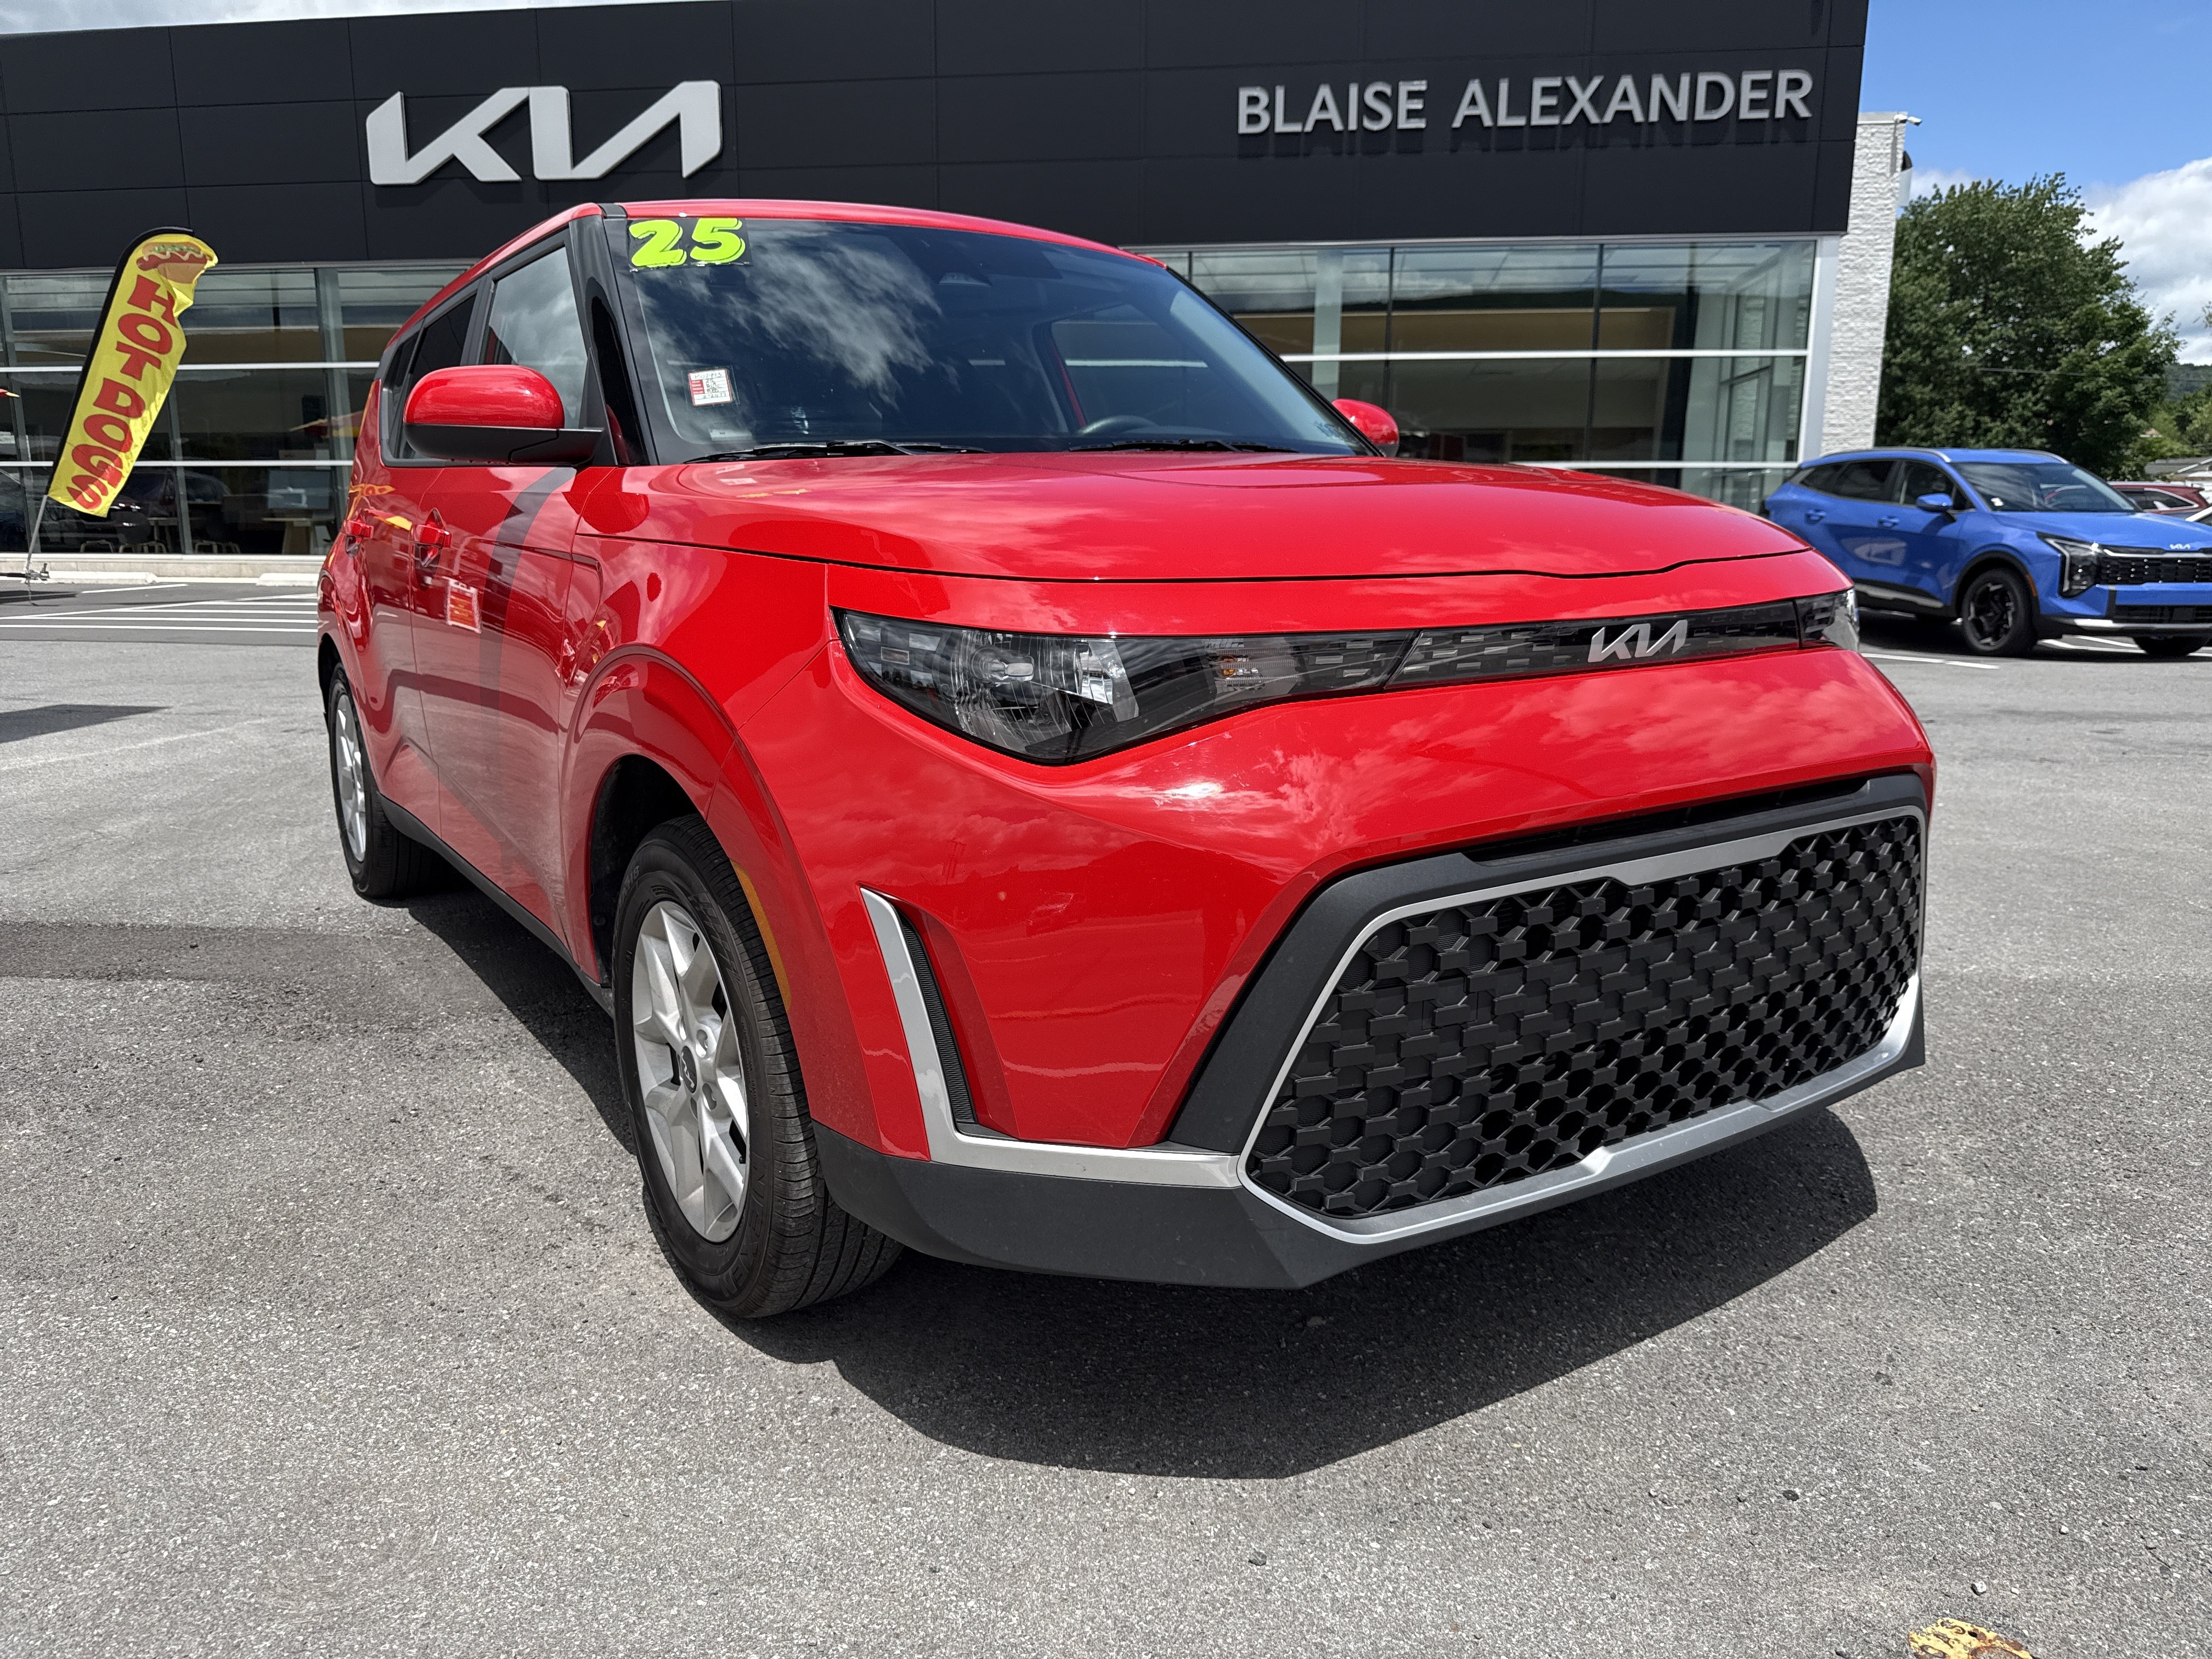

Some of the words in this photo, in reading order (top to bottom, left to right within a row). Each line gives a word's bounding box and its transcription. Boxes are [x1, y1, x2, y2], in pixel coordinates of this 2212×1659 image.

[366, 80, 721, 185] KIA
[1238, 79, 1427, 136] BLAISE
[1452, 69, 1813, 128] ALEXANDER
[629, 218, 746, 268] 25
[116, 275, 178, 381] HOT
[66, 377, 146, 510] DOGS
[1587, 620, 1688, 663] KIA
